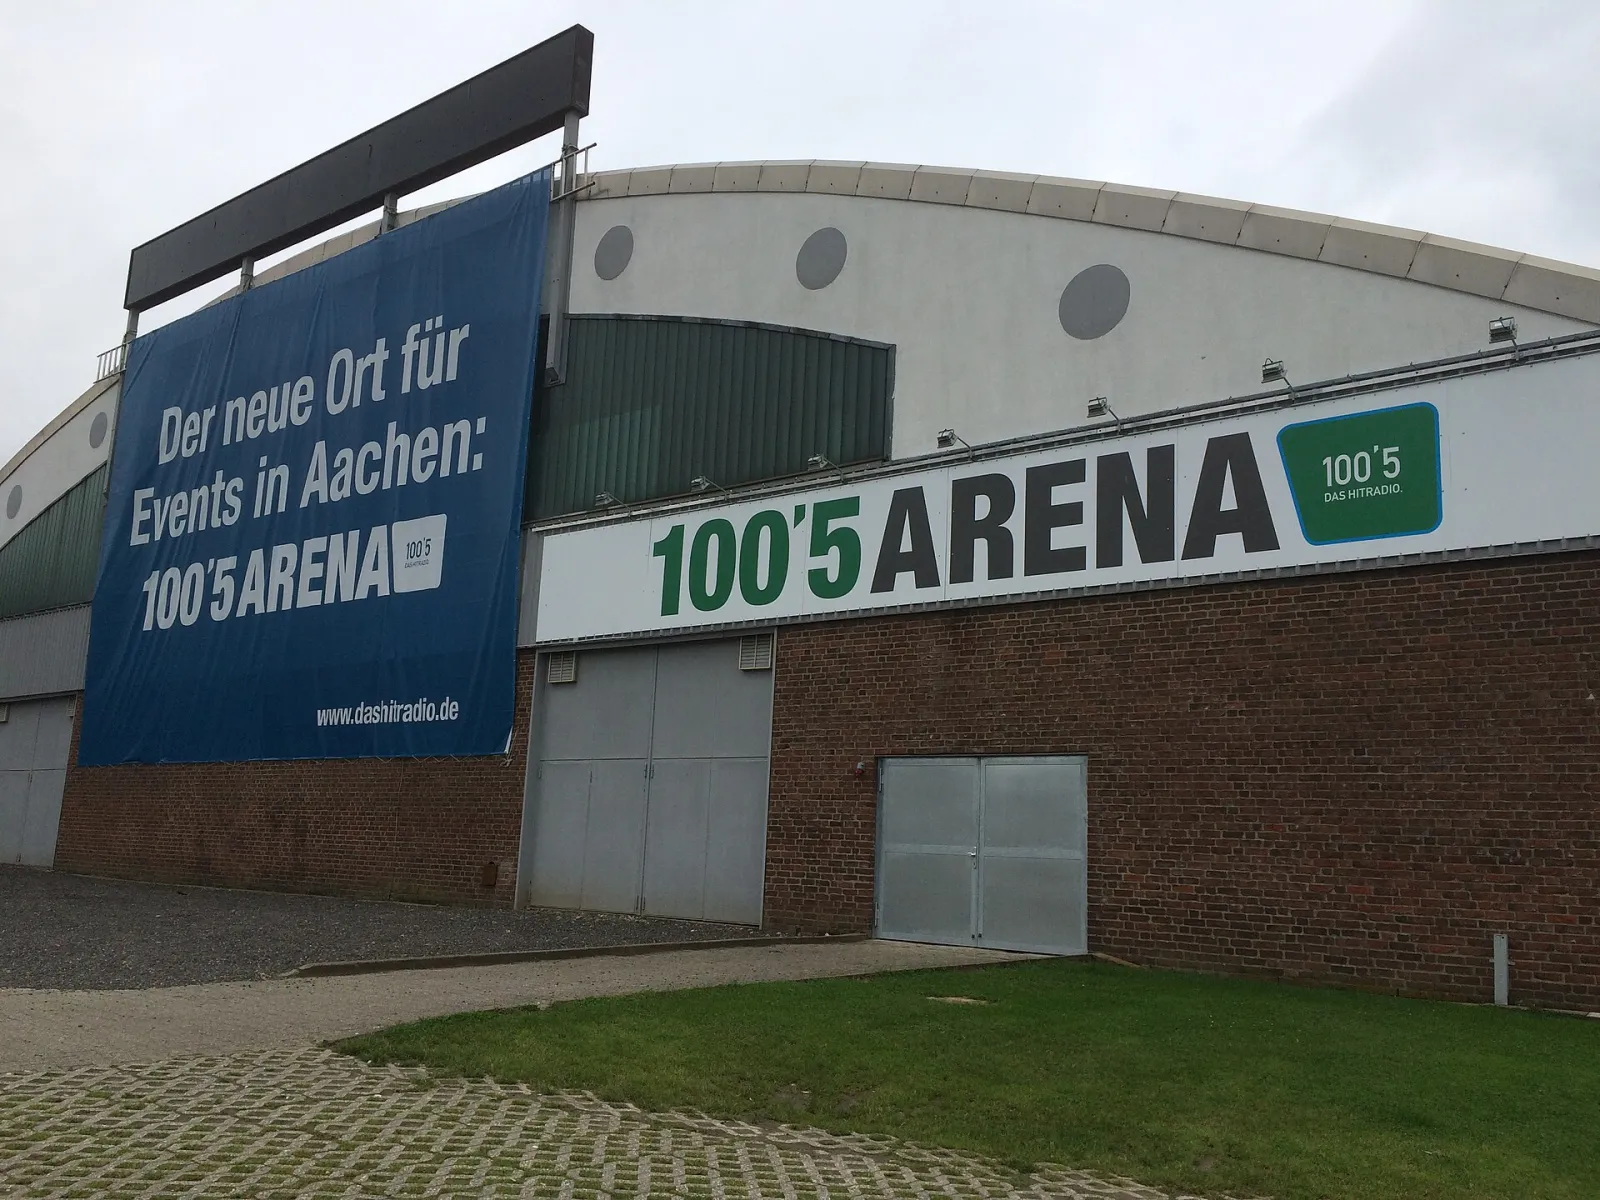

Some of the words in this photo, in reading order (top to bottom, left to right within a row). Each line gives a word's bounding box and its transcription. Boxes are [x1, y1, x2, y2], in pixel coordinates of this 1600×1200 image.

[158, 403, 216, 465] Der
[222, 375, 314, 446] neue
[326, 337, 389, 416] Ort
[401, 314, 470, 394] für
[130, 470, 244, 547] Events
[253, 456, 289, 518] in
[299, 416, 487, 508] Aachen:
[1322, 444, 1401, 487] 100'5
[1324, 490, 1346, 503] DAS
[1348, 483, 1403, 499] HITRADIO.
[142, 555, 237, 632] 100'5
[235, 524, 390, 618] ARENA
[652, 495, 861, 617] 100'5
[870, 431, 1281, 595] ARENA
[316, 696, 459, 727] www.dashitradio.de
